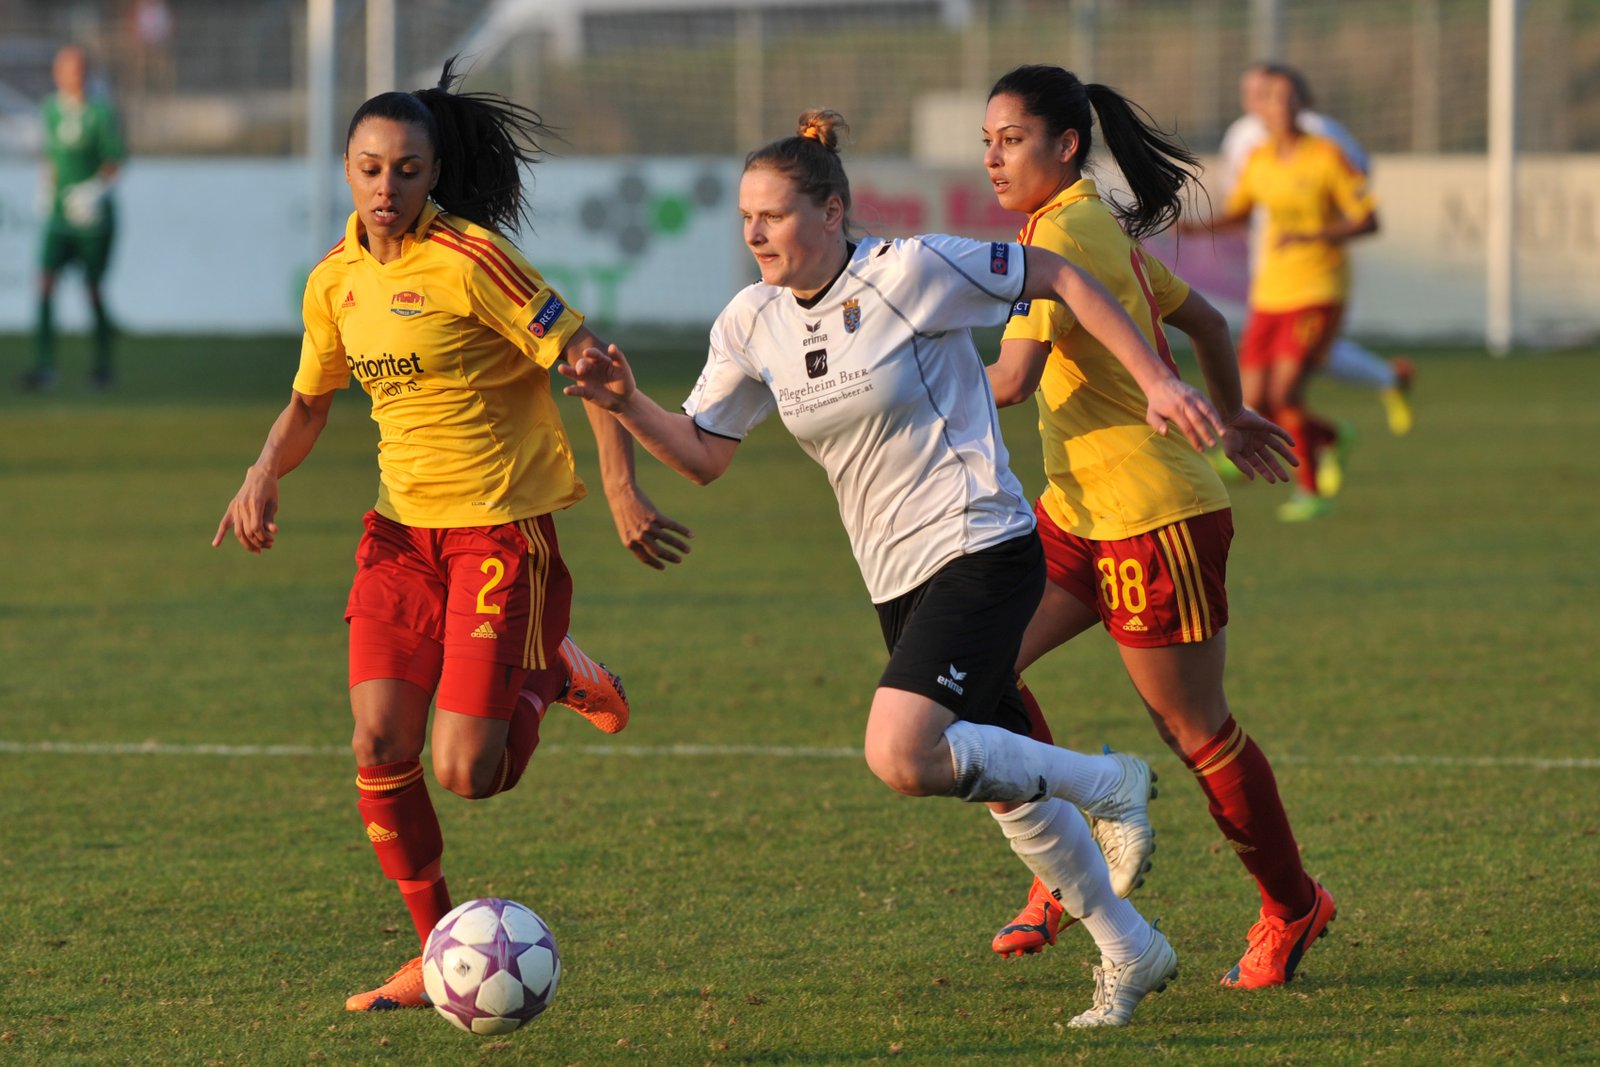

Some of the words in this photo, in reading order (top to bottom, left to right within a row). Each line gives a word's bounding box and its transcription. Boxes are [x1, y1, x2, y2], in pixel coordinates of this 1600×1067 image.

[802, 333, 828, 346] erima
[346, 352, 424, 378] Prioritet
[778, 379, 836, 403] Pflegeheim
[476, 557, 505, 615] 2
[1097, 557, 1147, 614] 88
[471, 631, 498, 640] adidas
[936, 675, 964, 696] erima
